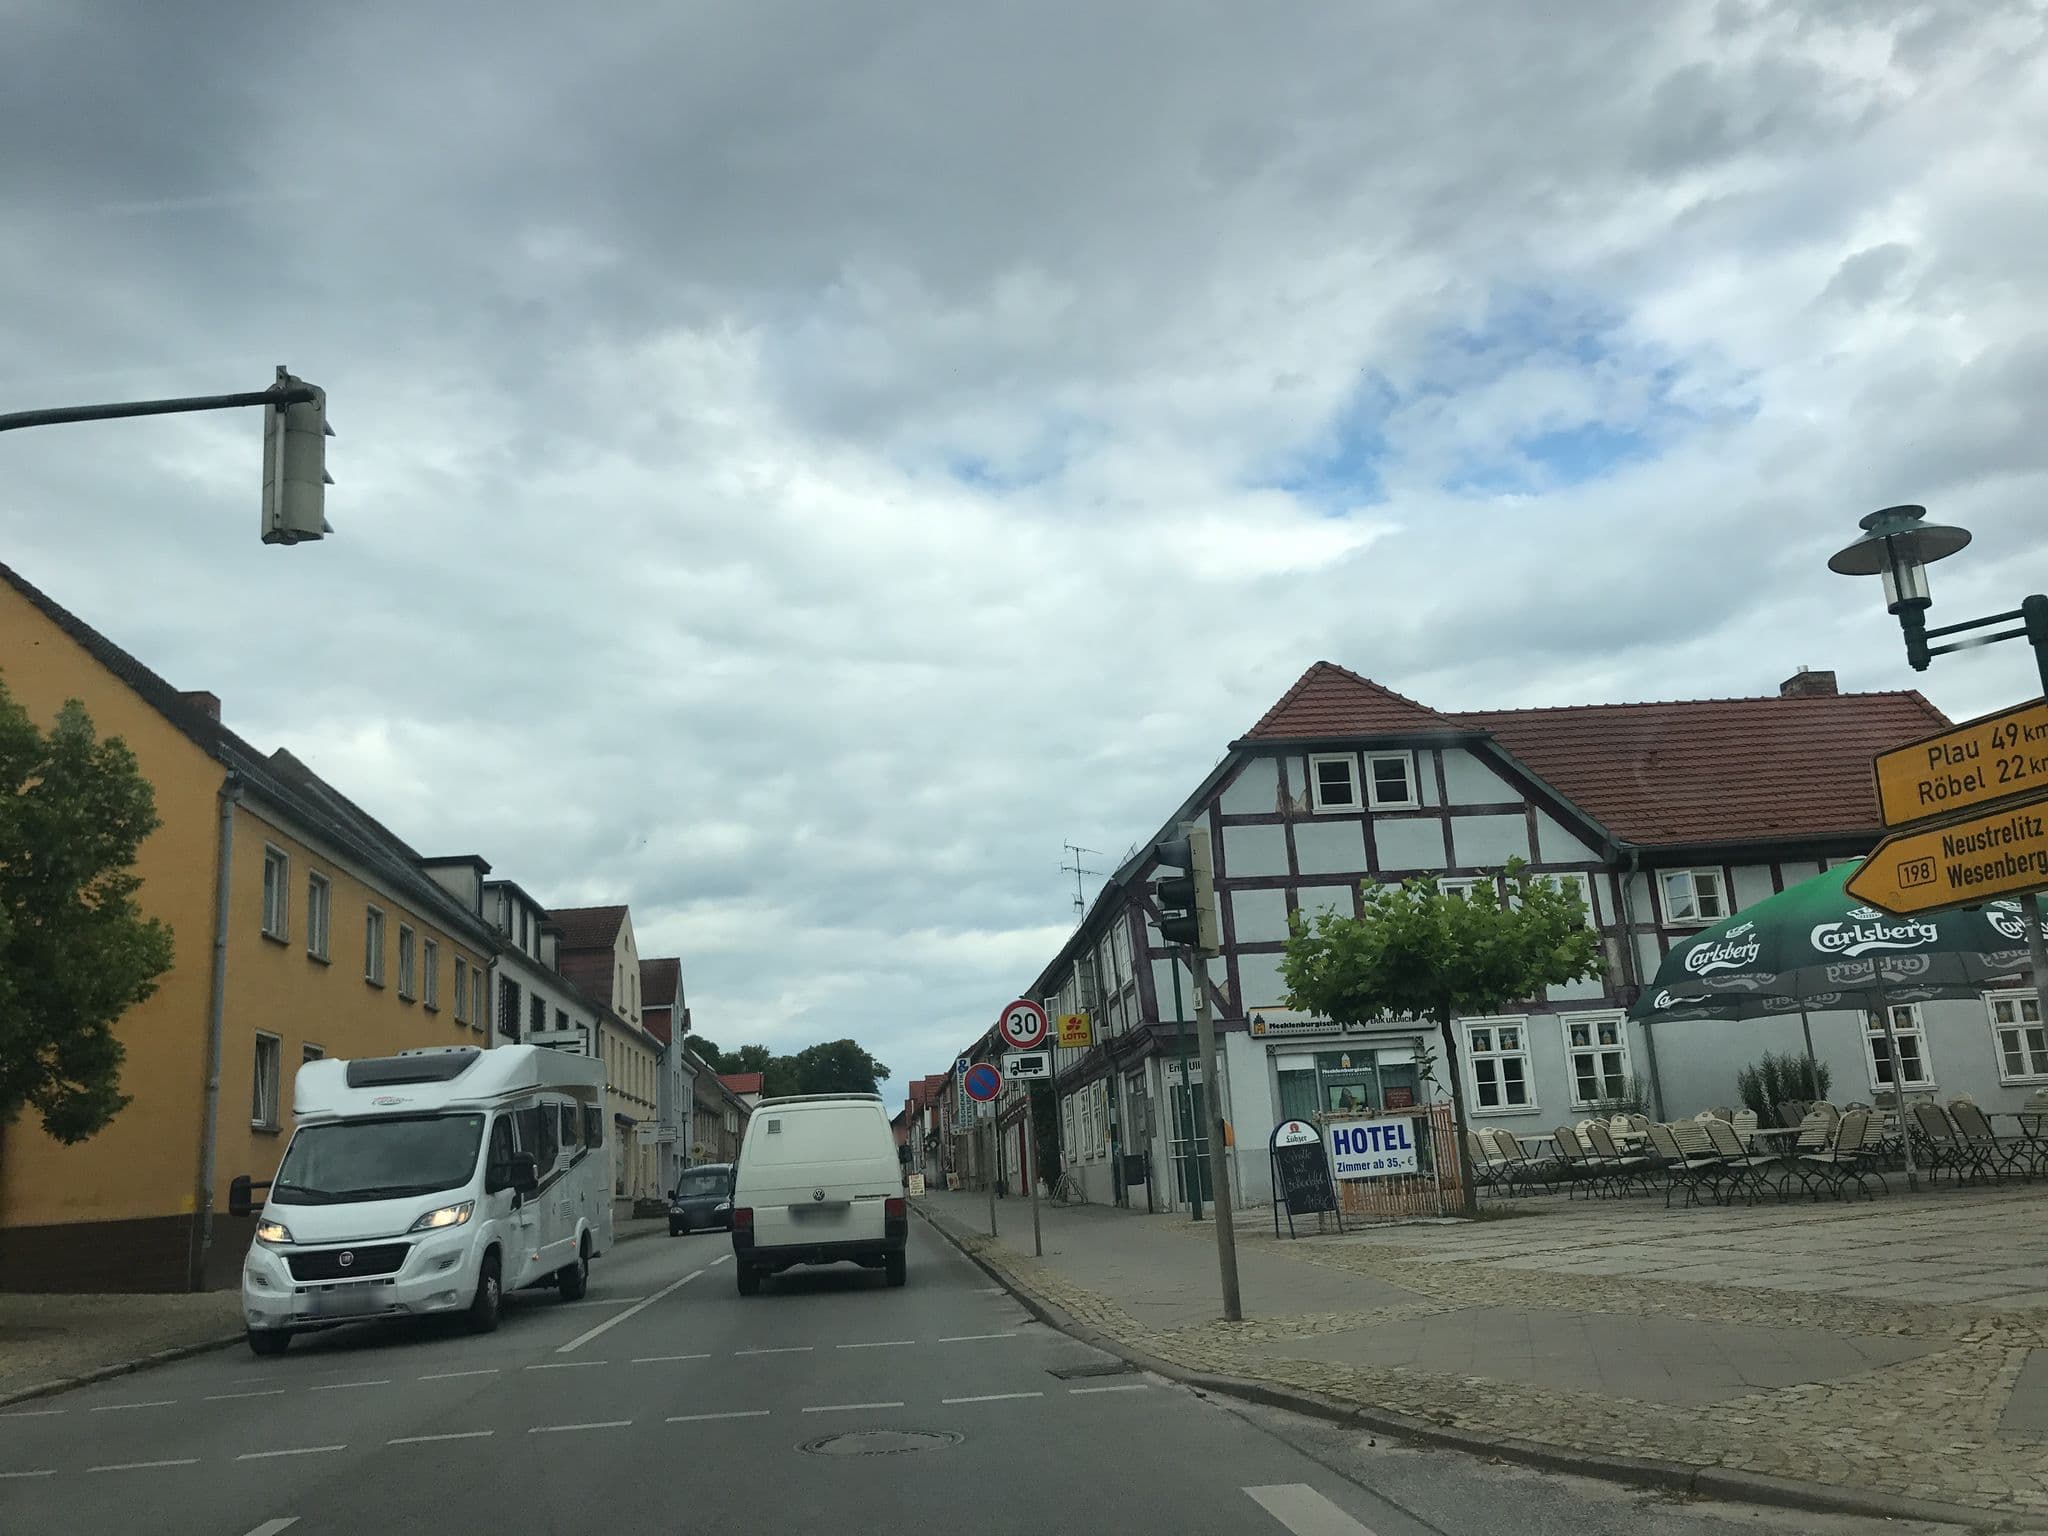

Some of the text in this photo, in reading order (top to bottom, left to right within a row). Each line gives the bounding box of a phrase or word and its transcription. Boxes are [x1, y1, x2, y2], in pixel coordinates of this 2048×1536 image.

[1927, 740, 1980, 770] Plau
[1991, 722, 2018, 751] 49
[1917, 766, 1986, 805] Röbel
[1995, 754, 2027, 784] 22
[1942, 816, 2044, 859] Neustrelitz
[1903, 863, 1930, 883] 198
[1946, 849, 2048, 889] Wesenberg
[1810, 920, 1938, 954] Carlsberg
[1684, 939, 1761, 976] Carlsberg
[1009, 1013, 1037, 1035] 30
[1062, 1032, 1088, 1041] LOTTO
[1332, 1124, 1412, 1156] HOTEL
[1336, 1156, 1415, 1173] Zimmer ab 35,- €
